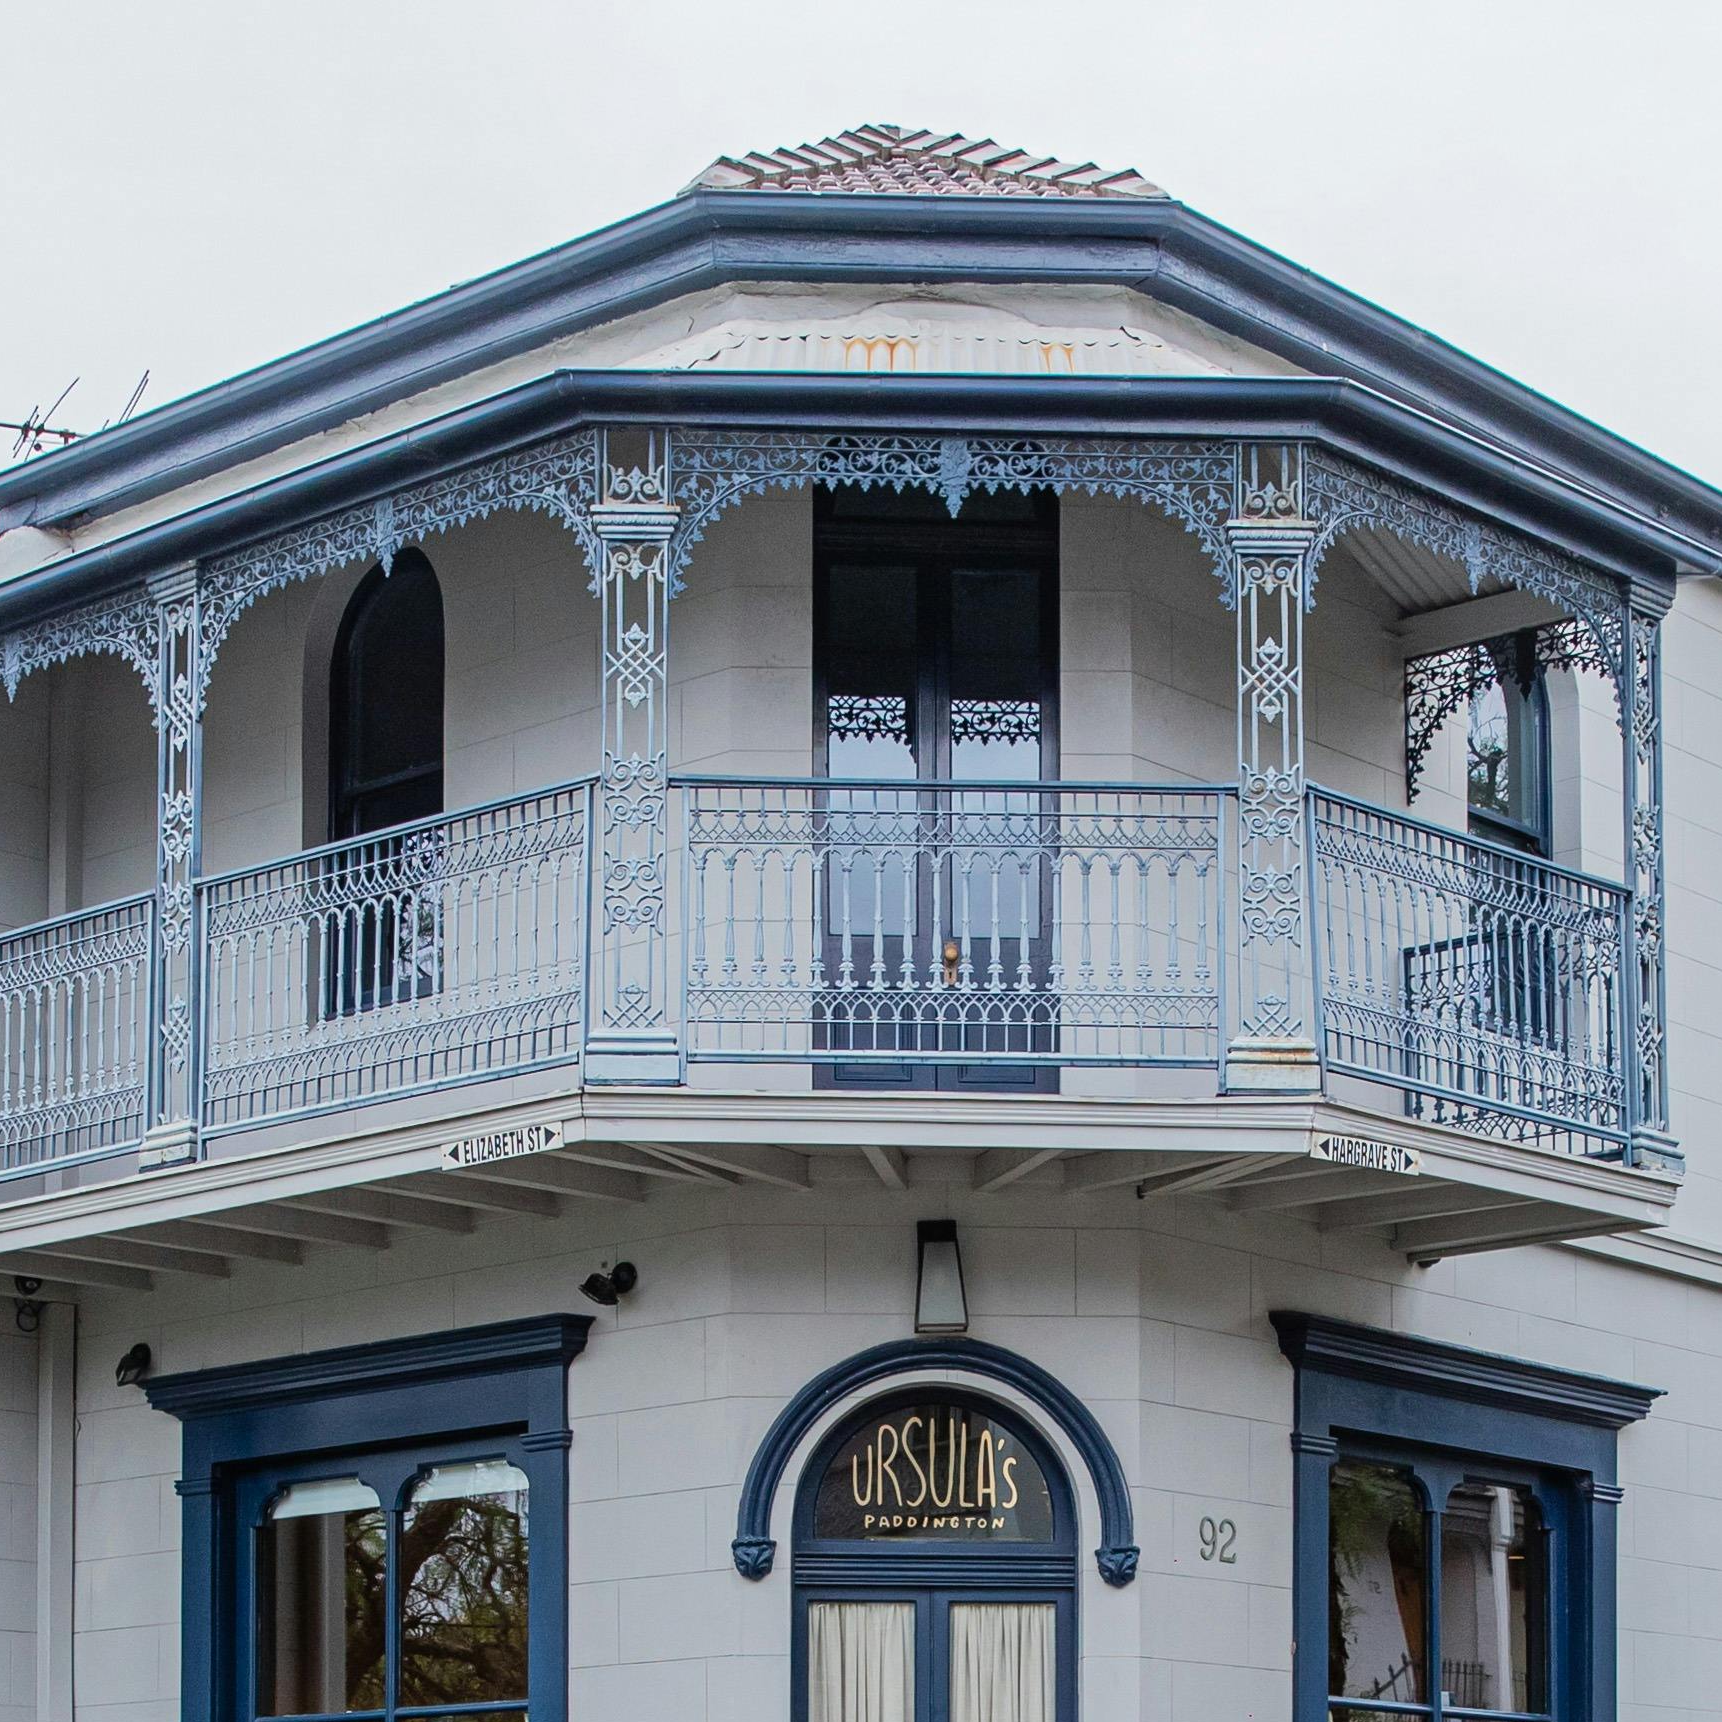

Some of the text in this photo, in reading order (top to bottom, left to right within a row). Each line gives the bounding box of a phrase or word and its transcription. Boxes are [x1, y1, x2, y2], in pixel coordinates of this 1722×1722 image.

[463, 1126, 541, 1164] ELIZABETH ST
[1332, 1137, 1403, 1171] HARGRAVE ST
[864, 1513, 1005, 1530] PADDINGTON
[1199, 1515, 1238, 1564] 92
